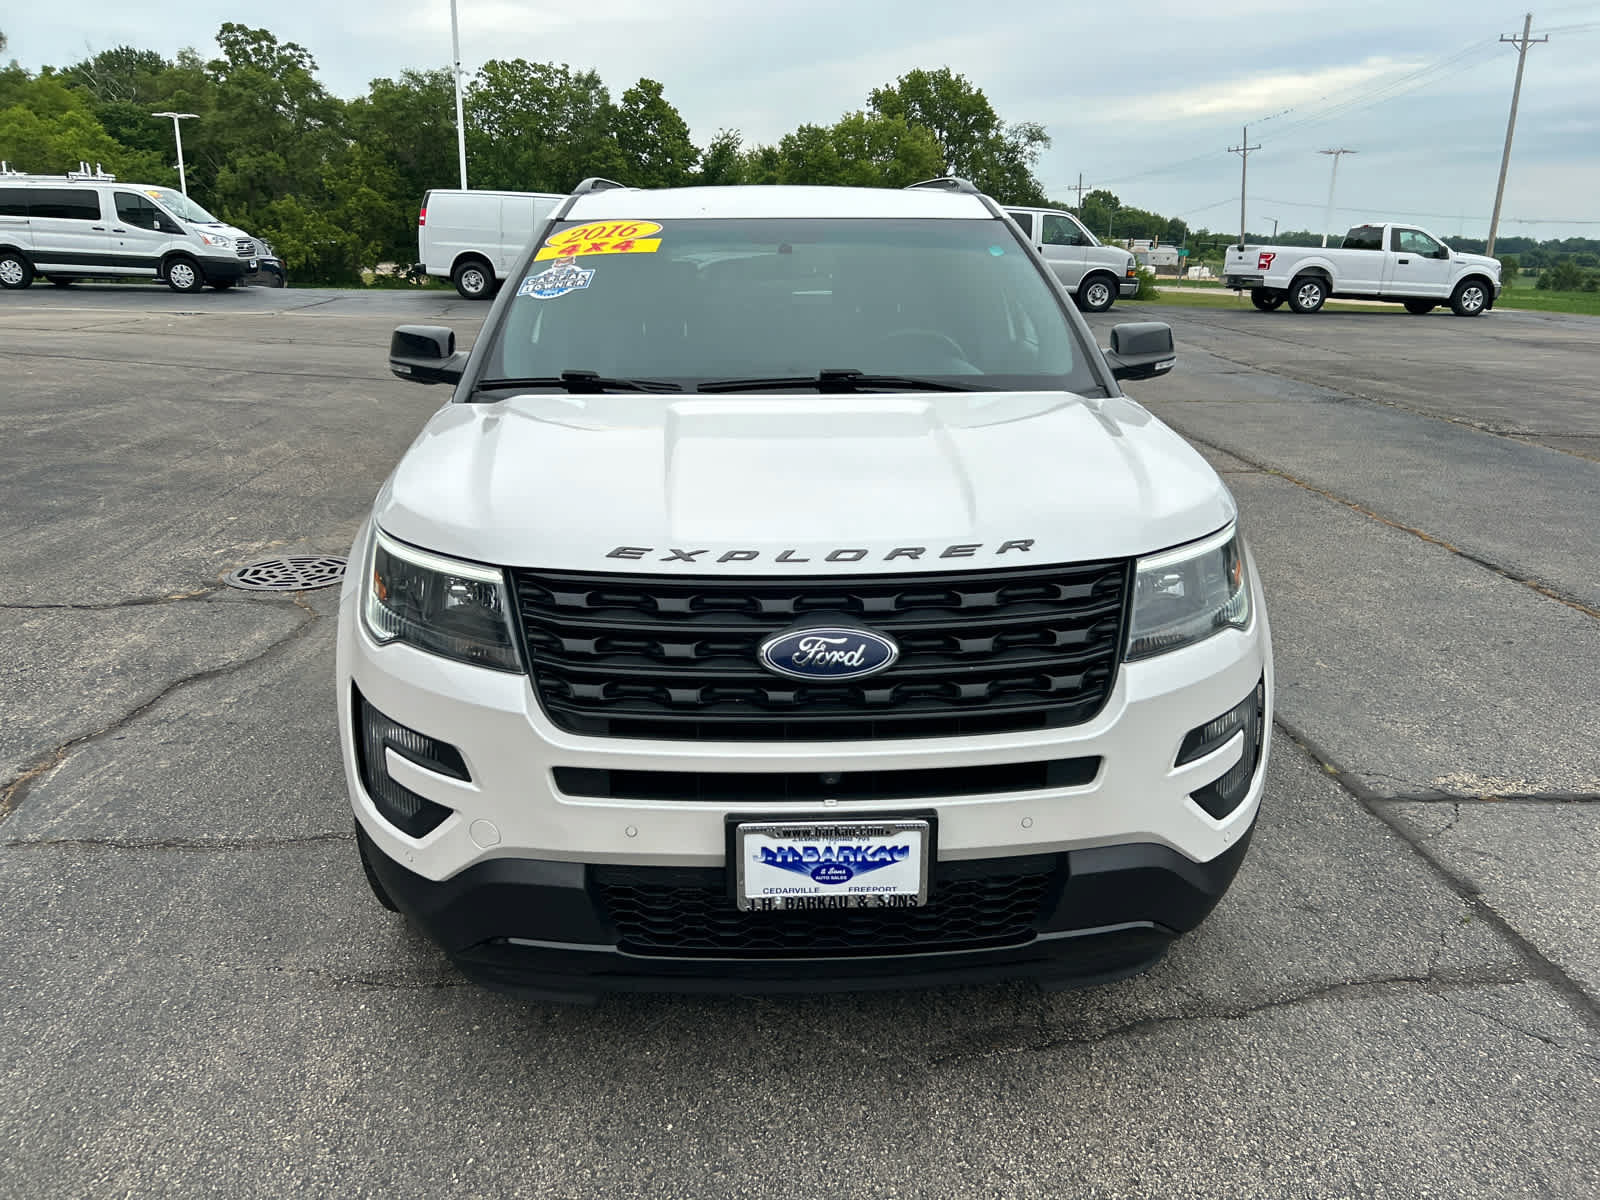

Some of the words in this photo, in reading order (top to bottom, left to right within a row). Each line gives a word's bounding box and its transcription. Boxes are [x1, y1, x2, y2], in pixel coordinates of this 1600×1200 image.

[562, 222, 643, 245] 2016
[534, 280, 585, 291] OWNER
[605, 538, 1036, 563] EXPLORER
[792, 636, 866, 669] Ford
[763, 887, 820, 895] CEDARVILLE
[785, 895, 849, 911] BARKAU
[858, 895, 868, 908] &
[877, 894, 918, 909] SONS
